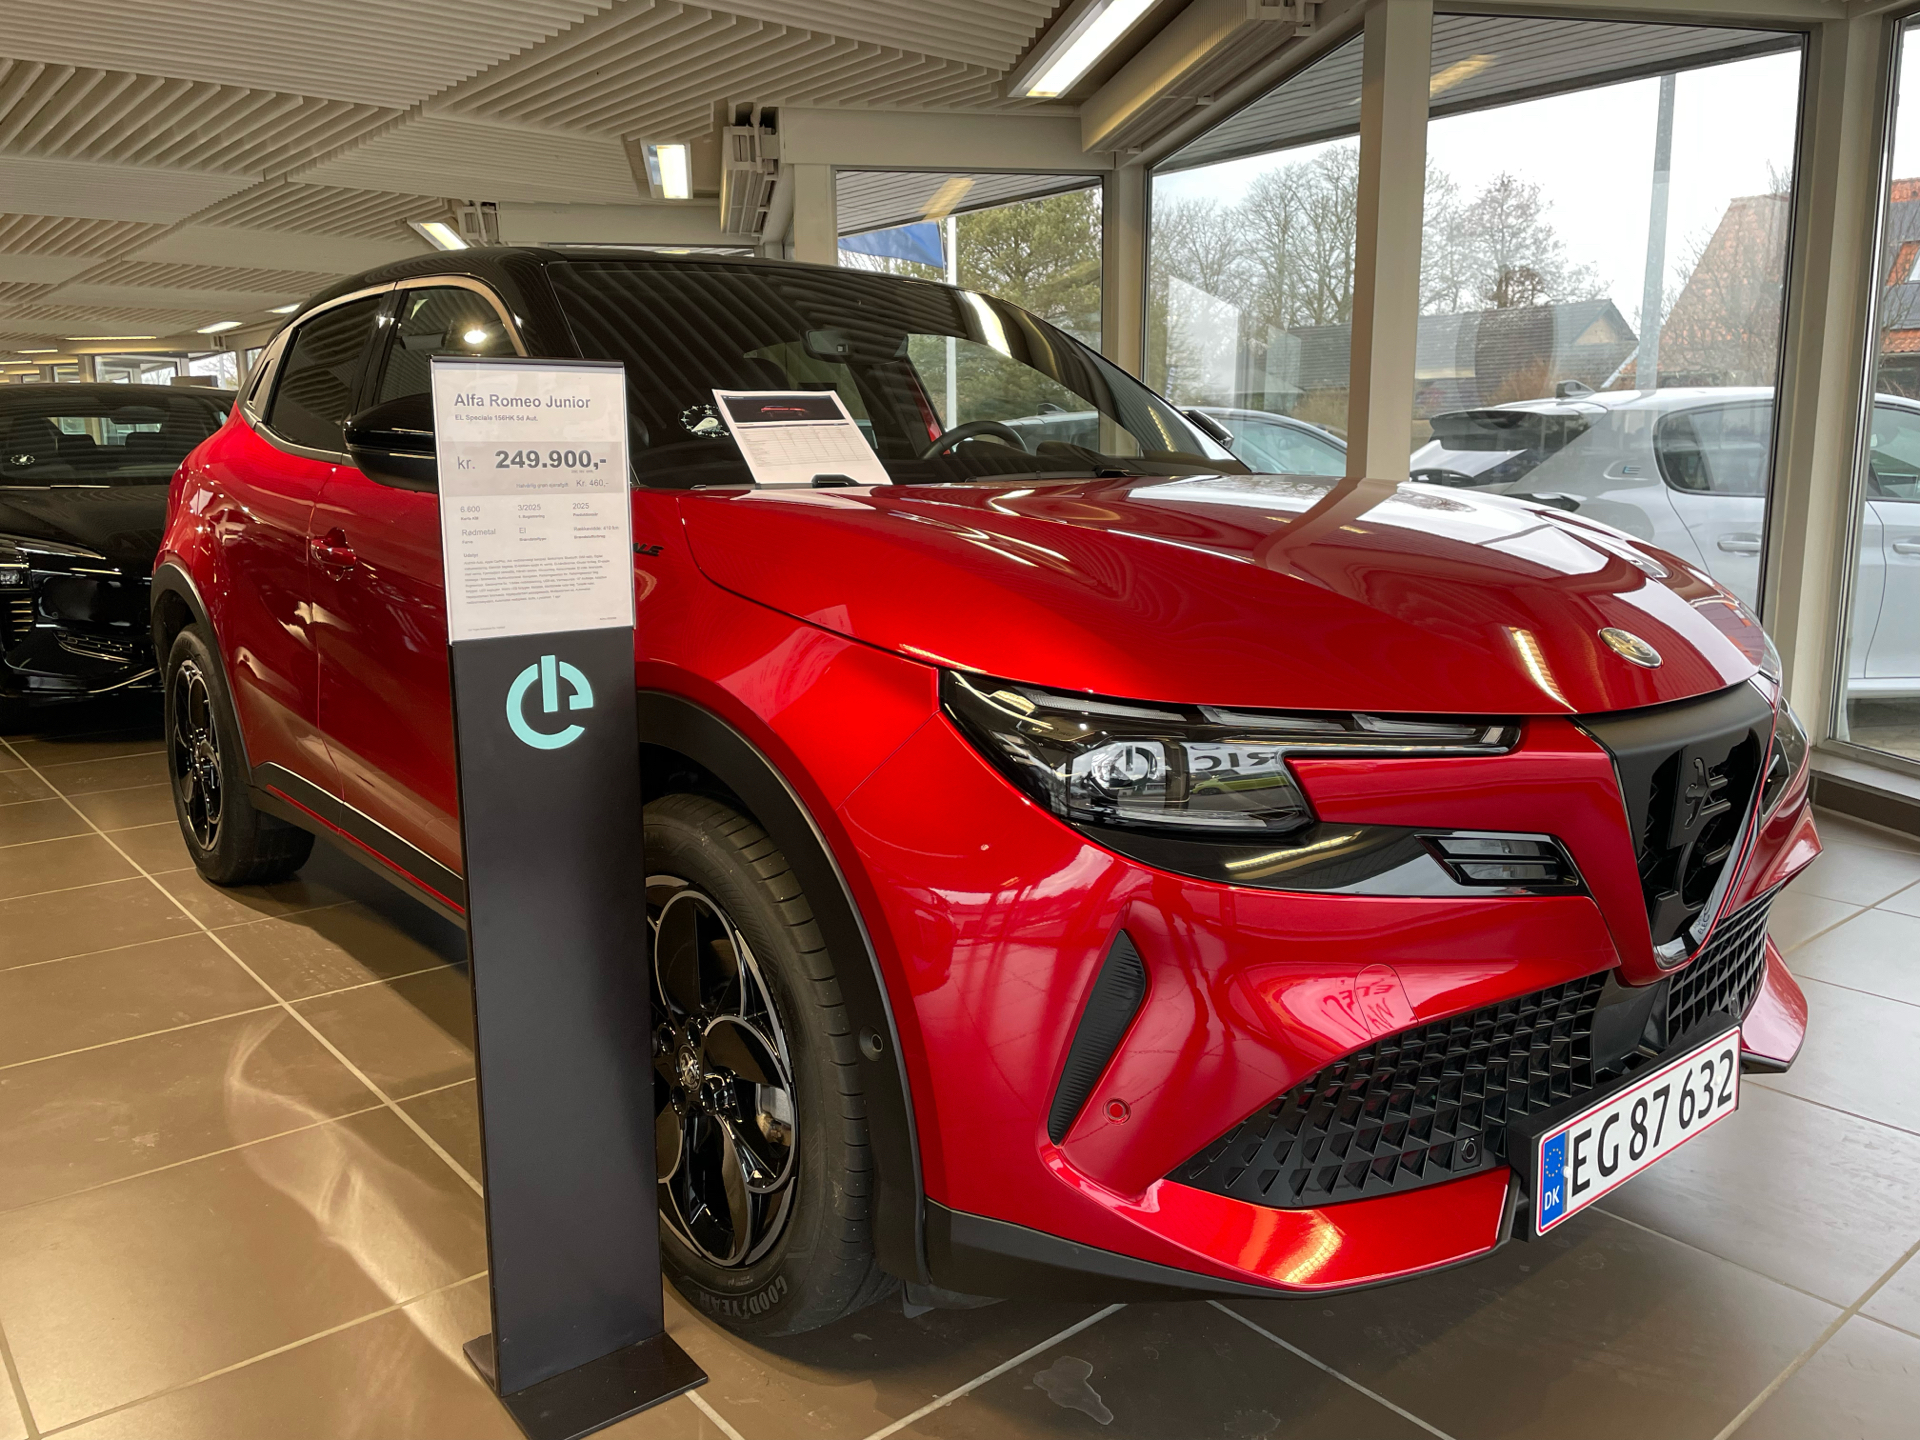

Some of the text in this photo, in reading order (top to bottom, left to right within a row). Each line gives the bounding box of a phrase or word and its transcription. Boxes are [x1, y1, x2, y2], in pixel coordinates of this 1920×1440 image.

[454, 394, 591, 409] Alfa Romeo Junior
[465, 414, 493, 422] Speciale
[457, 450, 607, 470] kr. 249.900,-
[589, 479, 609, 488] 460,-
[461, 528, 497, 536] Rødmetal
[1572, 1049, 1734, 1197] EG 87 632
[1544, 1185, 1560, 1211] DK
